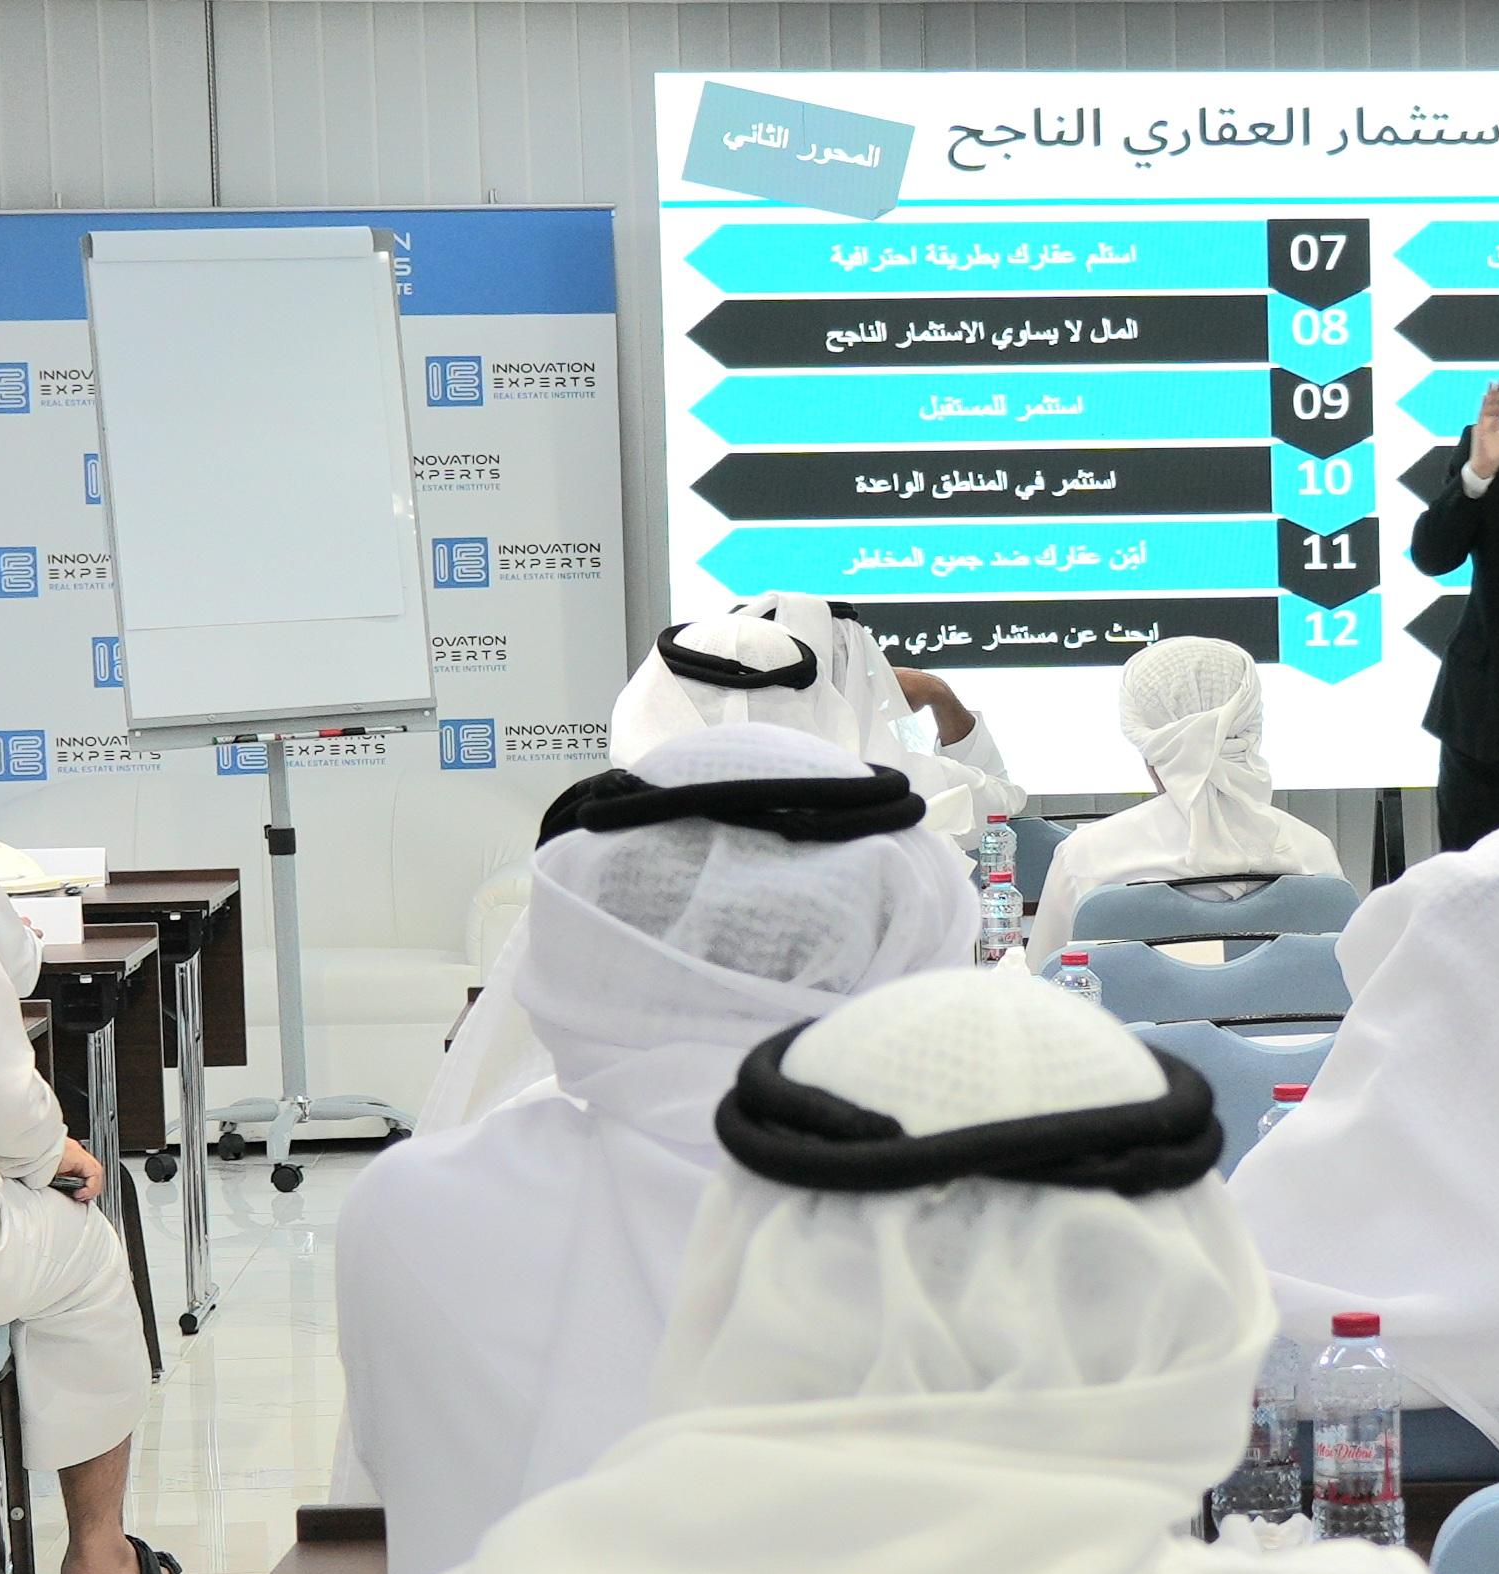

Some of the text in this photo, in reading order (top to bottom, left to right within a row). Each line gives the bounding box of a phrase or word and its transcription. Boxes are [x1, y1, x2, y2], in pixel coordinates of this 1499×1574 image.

[723, 122, 881, 168] المحور الثاني
[948, 107, 1101, 171] الناجح
[1123, 107, 1310, 168] العقاري
[830, 243, 915, 270] احترافية
[925, 244, 1000, 267] بطريقة
[1007, 245, 1076, 269] عقارك
[1290, 235, 1346, 271] 07
[825, 309, 1349, 353] 08 المال لا يساوي الاستثمار الناجح
[492, 362, 595, 374] INNOVATION
[494, 377, 596, 388] EXPERTS
[920, 383, 1350, 422] 09 استثمر للمستقبل
[855, 459, 1352, 500] 10 استثمر في المناطق الواعدة
[498, 543, 601, 555] INNOVATION
[843, 546, 924, 574] المخاطر
[991, 550, 1030, 566] ضد
[1034, 544, 1100, 572] عقارك
[1303, 533, 1356, 570] 11
[499, 557, 601, 569] EXPERTS
[931, 554, 983, 577] جميع
[905, 610, 1359, 655] 12 ابحث عن مستشار عقاري
[505, 723, 607, 736] INNOVATION
[285, 744, 386, 756] EXPERTS
[505, 738, 608, 750] EXPERTS
